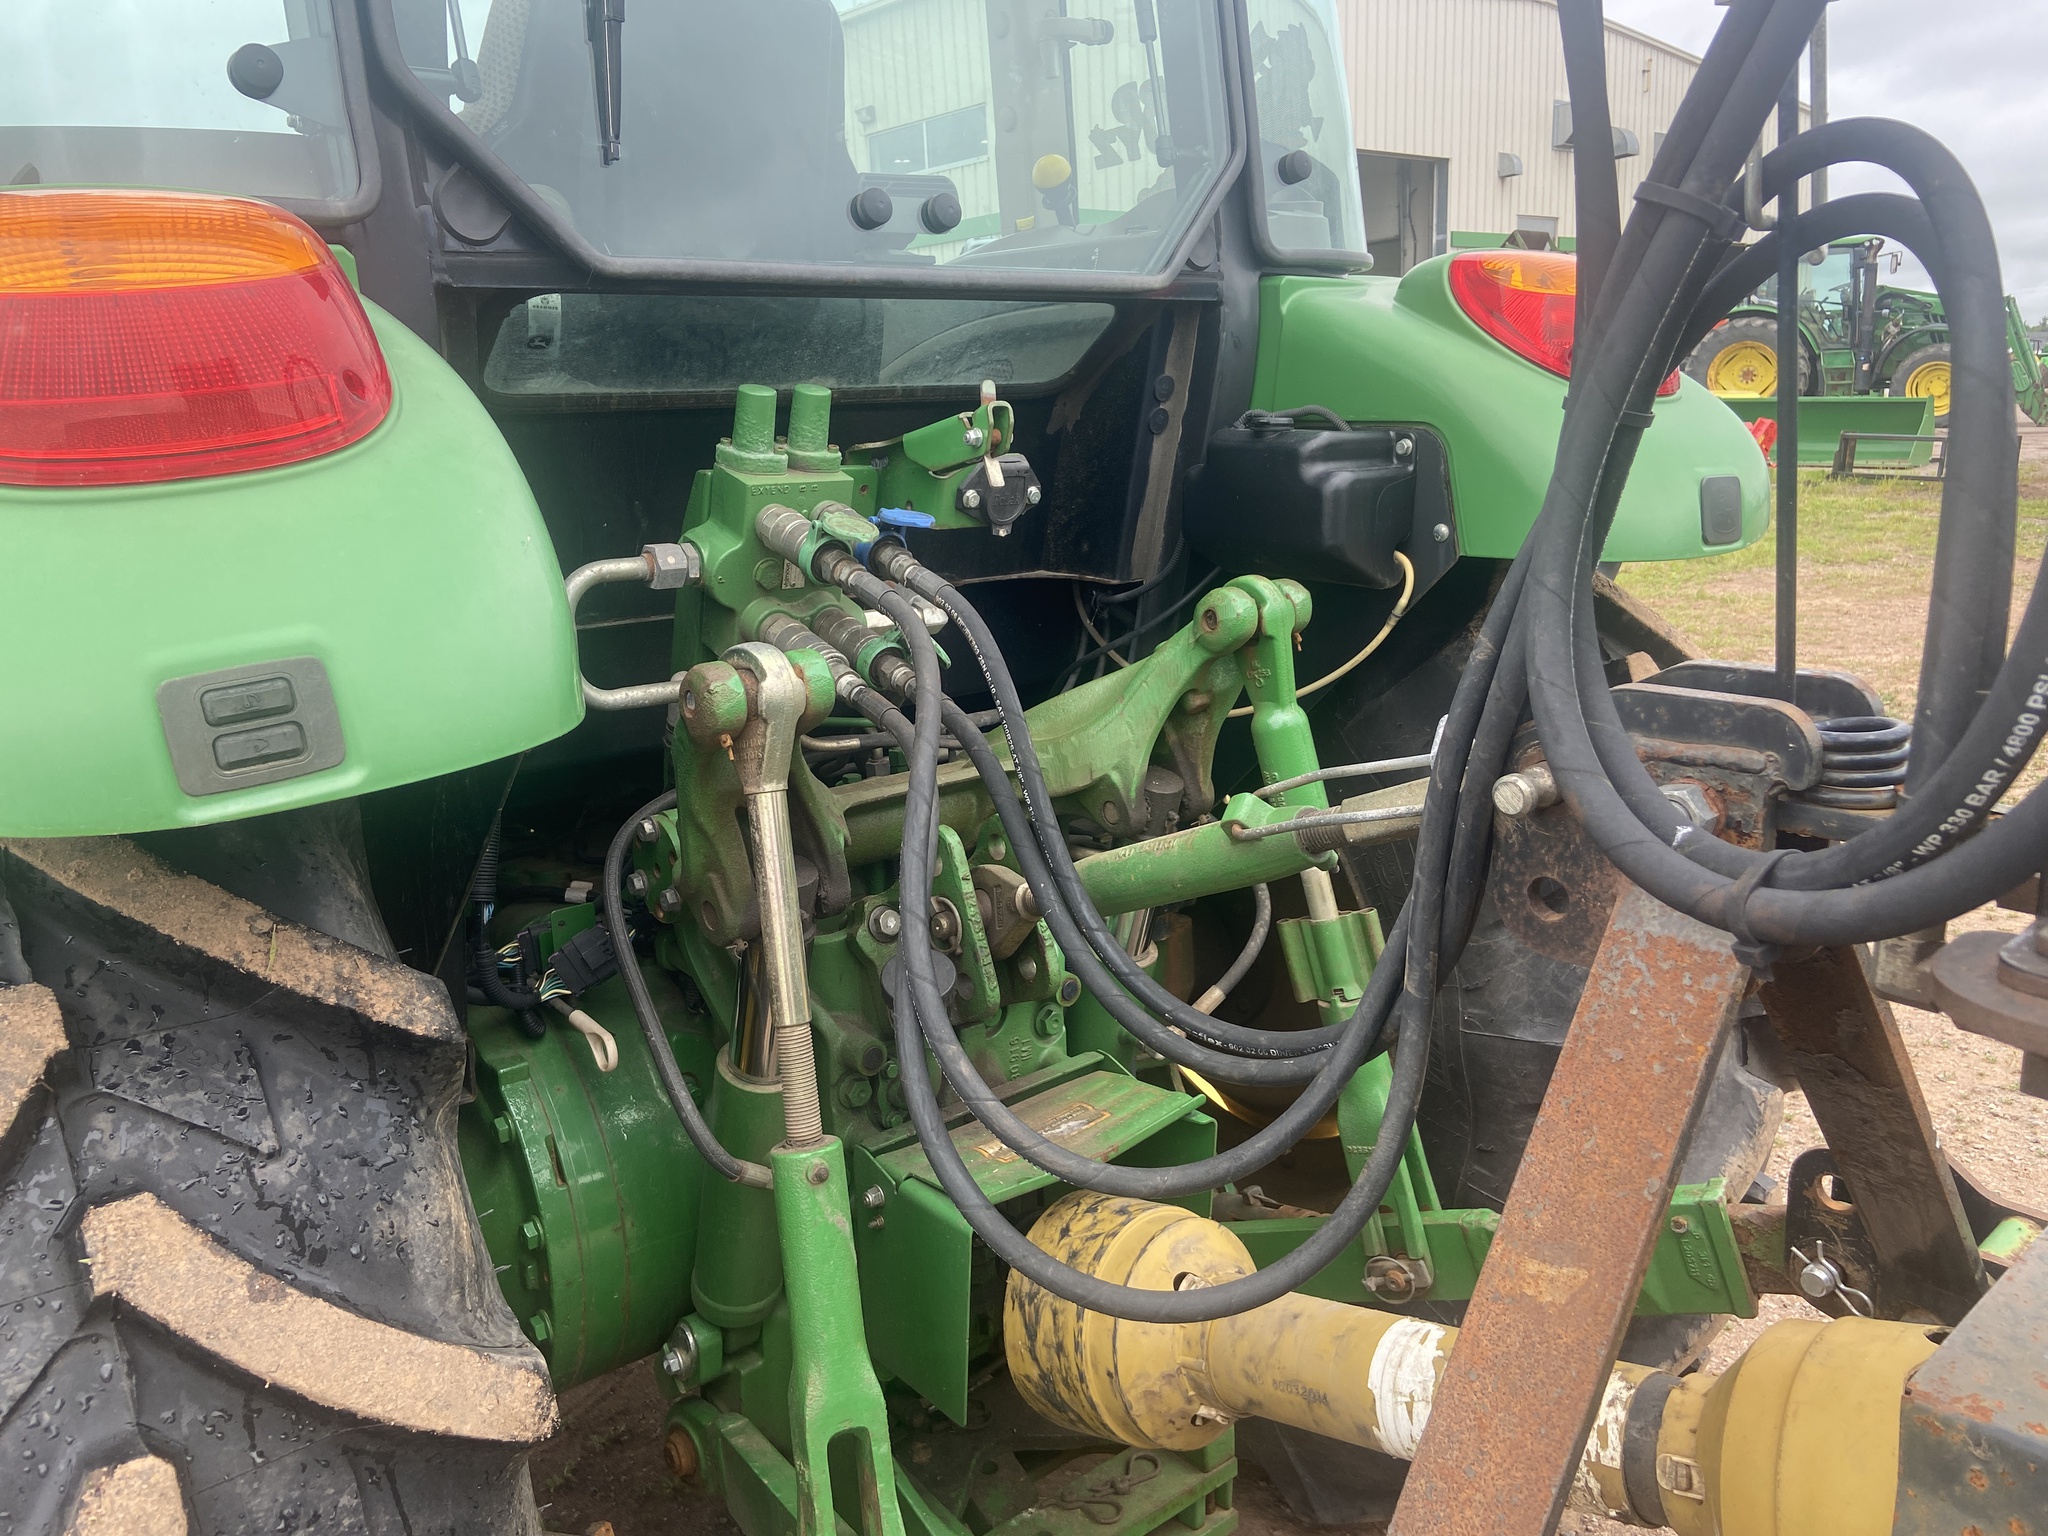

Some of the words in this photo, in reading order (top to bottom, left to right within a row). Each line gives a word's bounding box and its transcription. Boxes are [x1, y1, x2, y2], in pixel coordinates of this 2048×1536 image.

[751, 484, 790, 496] EXTEND
[1911, 834, 1942, 855] WP
[1939, 808, 1975, 833] 330
[1963, 769, 2007, 806] BAR
[2001, 712, 2041, 758] 4800
